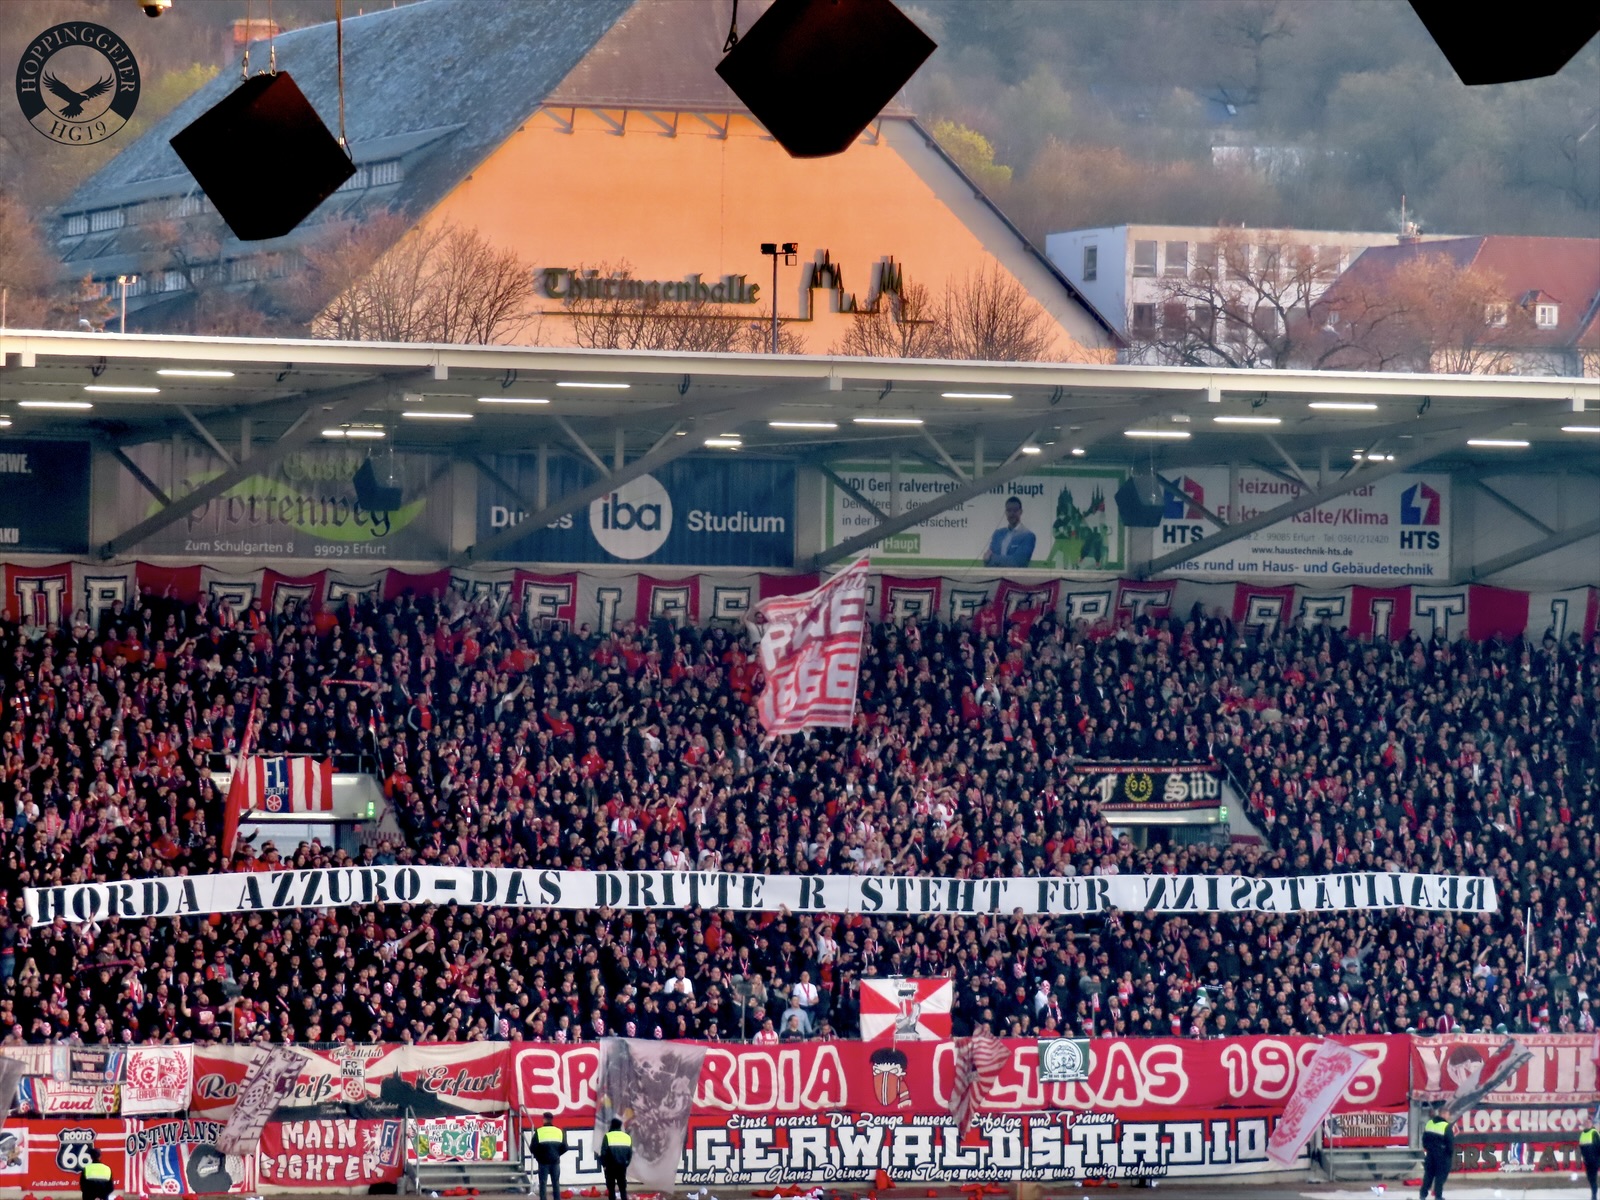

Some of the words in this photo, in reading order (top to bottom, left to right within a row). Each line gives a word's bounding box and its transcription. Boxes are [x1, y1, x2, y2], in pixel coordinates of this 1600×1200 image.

[543, 266, 761, 304] Thüringenhalle
[868, 478, 966, 494] Genralvertretu
[1007, 481, 1044, 497] Haupt
[490, 505, 573, 530] Dus
[601, 492, 662, 532] iba
[687, 509, 785, 533] Studium
[842, 514, 852, 526] in
[854, 514, 872, 526] der
[884, 538, 919, 552] Haupt
[1162, 525, 1204, 544] HTS
[1293, 532, 1316, 542] Erfurt
[1400, 530, 1440, 550] HTS
[185, 541, 210, 552] Zum
[214, 540, 283, 555] Schulgarten
[287, 542, 294, 553] 8
[314, 544, 350, 556] 99092
[353, 543, 386, 554] Erfurt
[1251, 546, 1353, 557] www.haustechnik-hts.de
[1204, 559, 1234, 572] rund
[1238, 562, 1259, 572] um
[1262, 560, 1299, 574] Haus-
[1303, 560, 1328, 574] und
[1332, 560, 1434, 576] Gebäudetechnik
[865, 586, 1178, 628] RFURT
[265, 756, 285, 789] FC
[264, 786, 289, 796] ERFURT
[1130, 780, 1146, 792] 98
[1162, 771, 1219, 803] Süd
[36, 878, 200, 923] HORDA
[239, 867, 421, 910] AZZURO
[470, 869, 562, 906] DAS
[594, 872, 766, 909] DRITTE
[798, 876, 827, 910] R
[860, 876, 1008, 912] STEHT
[1036, 877, 1111, 913] FÜR
[164, 1058, 175, 1066] FC
[343, 1068, 362, 1076] RWE
[1416, 1046, 1597, 1092] YTH
[198, 1074, 240, 1100] Ro
[423, 1067, 502, 1099] Erfurt
[515, 1045, 847, 1115] ERRDIA
[49, 1096, 94, 1111] Land
[726, 1114, 767, 1129] Einst
[776, 1113, 818, 1127] warst
[826, 1111, 852, 1124] Du
[856, 1112, 904, 1128] Zeuge
[971, 1112, 1022, 1131] Erfolge
[1029, 1113, 1050, 1126] und
[1056, 1109, 1120, 1127] Tränen,
[1462, 1109, 1502, 1132] LOS
[1507, 1108, 1589, 1132] CHICOS
[63, 1130, 92, 1141] ROOTS
[281, 1119, 358, 1150] MAIN
[62, 1144, 93, 1169] 66
[260, 1152, 385, 1182] FIGHTER
[682, 1166, 716, 1183] nach
[725, 1166, 751, 1182] dem
[765, 1166, 812, 1182] Glanz
[823, 1163, 870, 1180] Deiner
[916, 1162, 960, 1180] Tage
[966, 1166, 1012, 1180] werden
[1020, 1166, 1044, 1180] wir
[1053, 1166, 1074, 1178] uns
[1085, 1164, 1116, 1180] ewig
[1124, 1161, 1168, 1176] sehnen
